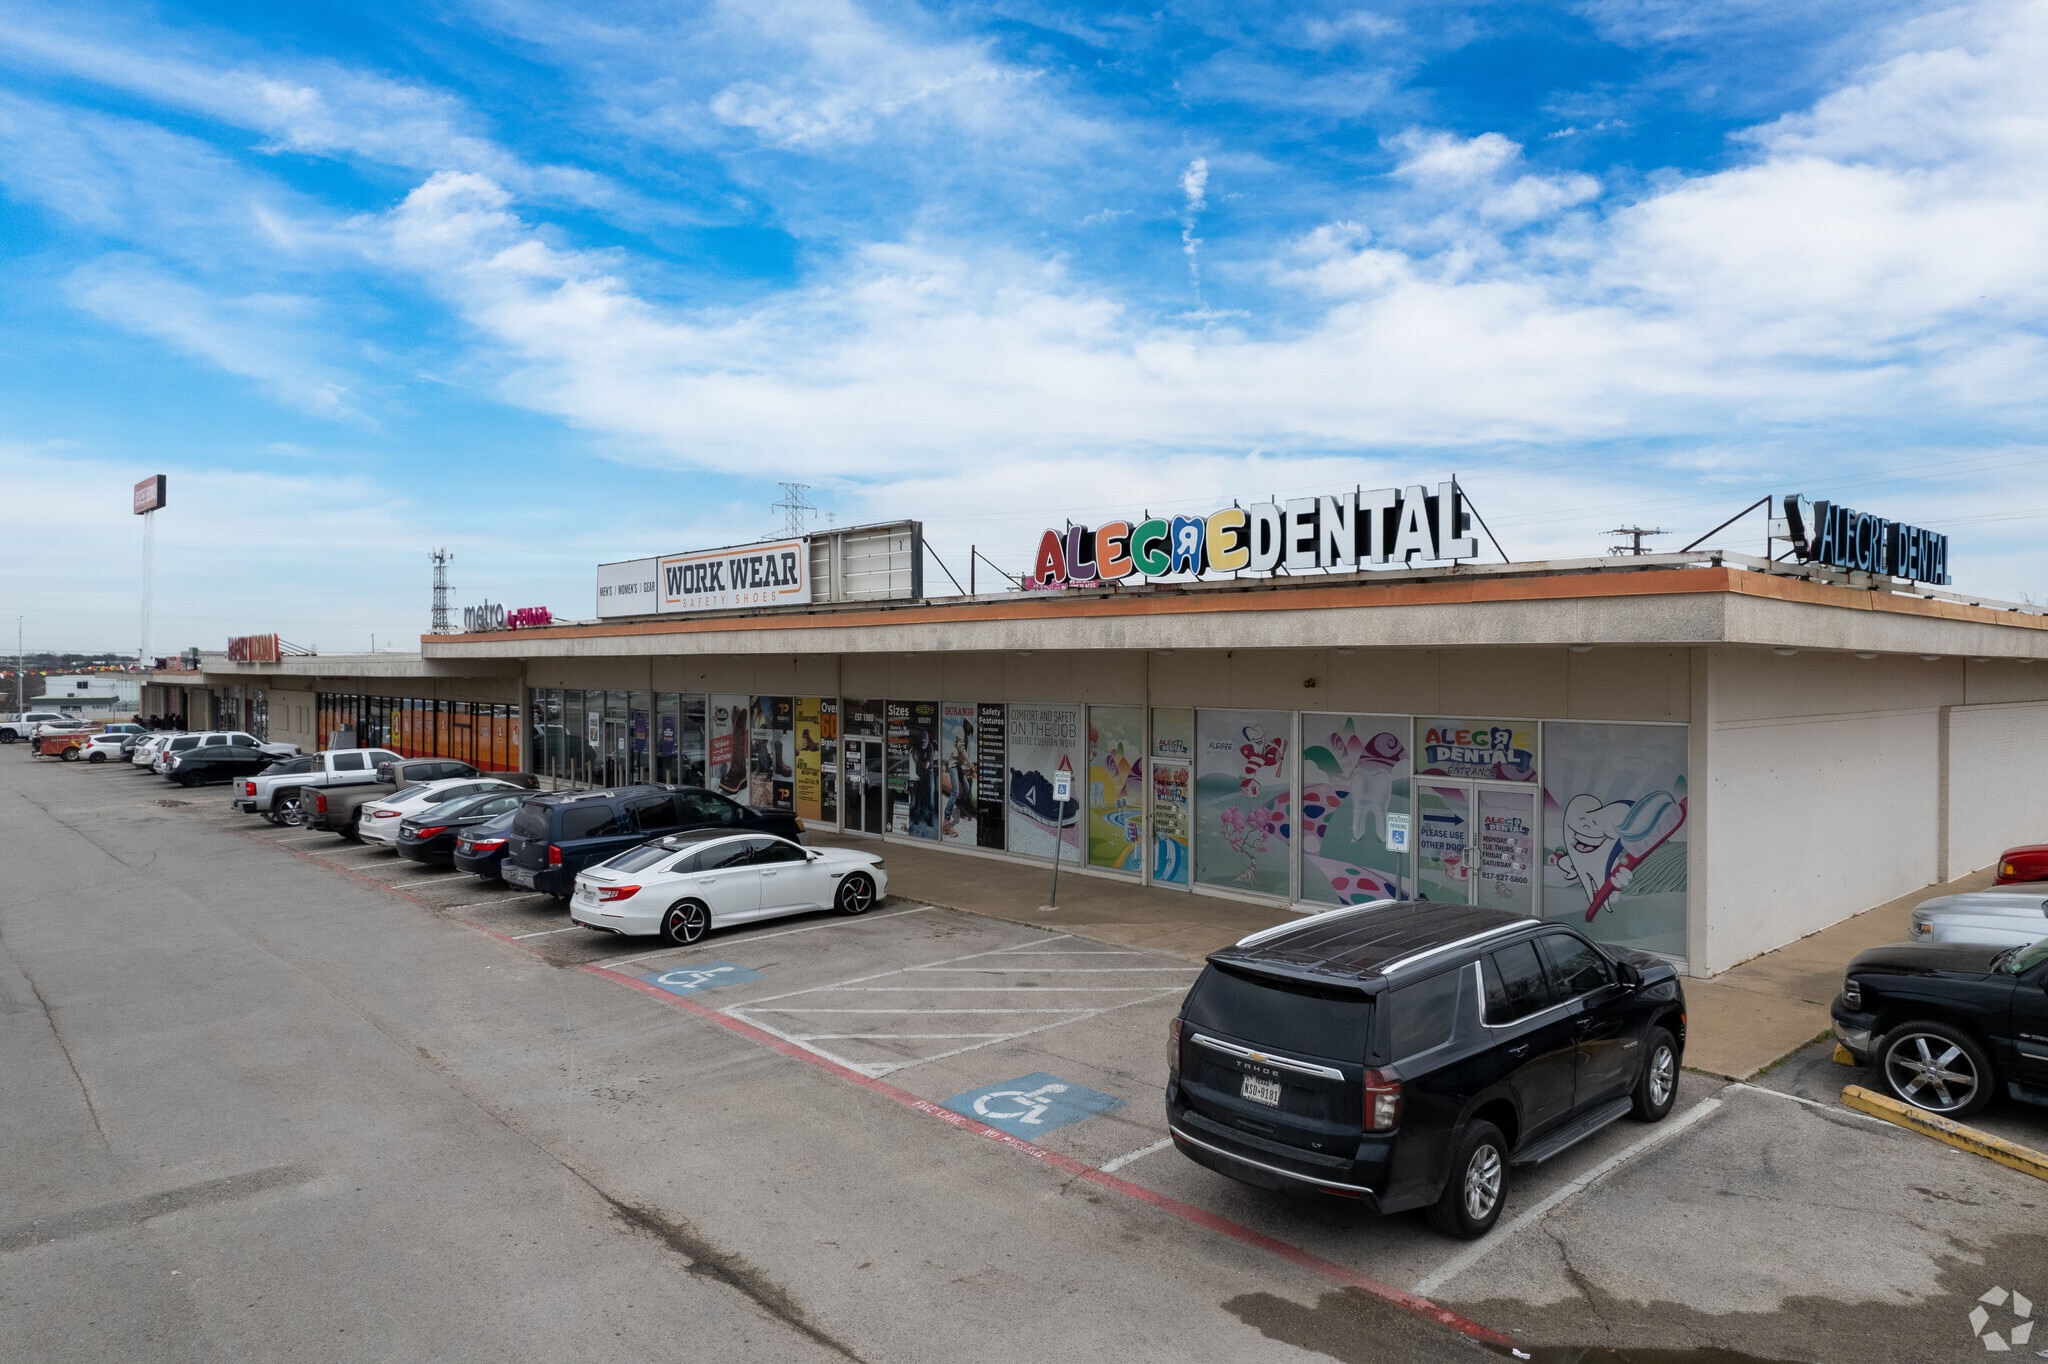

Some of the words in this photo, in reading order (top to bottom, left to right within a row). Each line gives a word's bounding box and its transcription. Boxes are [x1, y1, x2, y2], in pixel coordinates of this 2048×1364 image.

[1034, 507, 1249, 584] ALEGRE
[1249, 481, 1478, 573] DENTAL
[1819, 500, 1890, 575] ALEGRE
[1897, 522, 1951, 586] DENTAL
[666, 561, 725, 596] WORK
[729, 551, 798, 590] WEAR
[600, 586, 613, 597] MEN'S
[618, 583, 637, 595] WOMEN'S
[643, 581, 655, 593] GEAR
[682, 595, 726, 608] SAFETY
[735, 591, 776, 604] SHOES
[464, 598, 504, 628] metro
[888, 704, 909, 716] Sizes
[916, 705, 934, 714] KEEN
[945, 706, 974, 717] DURANGO
[982, 707, 1001, 717] Safety
[978, 716, 1004, 725] Features
[1011, 709, 1038, 721] COMFORT
[1040, 710, 1052, 722] AND
[1053, 711, 1076, 723] SAFETY
[821, 713, 837, 739] 60
[1011, 721, 1026, 735] ON
[1030, 722, 1051, 737] THE
[1055, 723, 1077, 738] JOB
[821, 738, 837, 747] Brand
[1011, 736, 1032, 746] SUBLITE
[1033, 737, 1058, 747] CUSHION
[1059, 738, 1077, 748] WORK
[1425, 727, 1532, 751] ALEGRE
[1208, 741, 1233, 750] ALEGRE
[1436, 747, 1521, 764] DENTAL
[1447, 766, 1497, 777] ENTRANCE
[1485, 816, 1522, 827] ALEGR
[1421, 829, 1448, 838] PLEASE
[1449, 831, 1464, 839] USE
[1490, 824, 1525, 833] DENTAL
[1421, 840, 1445, 850] OTHER
[1446, 843, 1467, 852] DOOR
[1483, 836, 1508, 844] MONDAY
[1483, 852, 1502, 860] FRIDAY
[1482, 860, 1512, 869] SATURDAY
[1481, 872, 1528, 884] 817-927-5800
[1236, 1060, 1279, 1077] TAHOE
[912, 1100, 938, 1113] FIRE
[936, 1110, 967, 1125] LANE
[980, 1128, 1000, 1138] NO
[1001, 1136, 1047, 1158] PARKING
